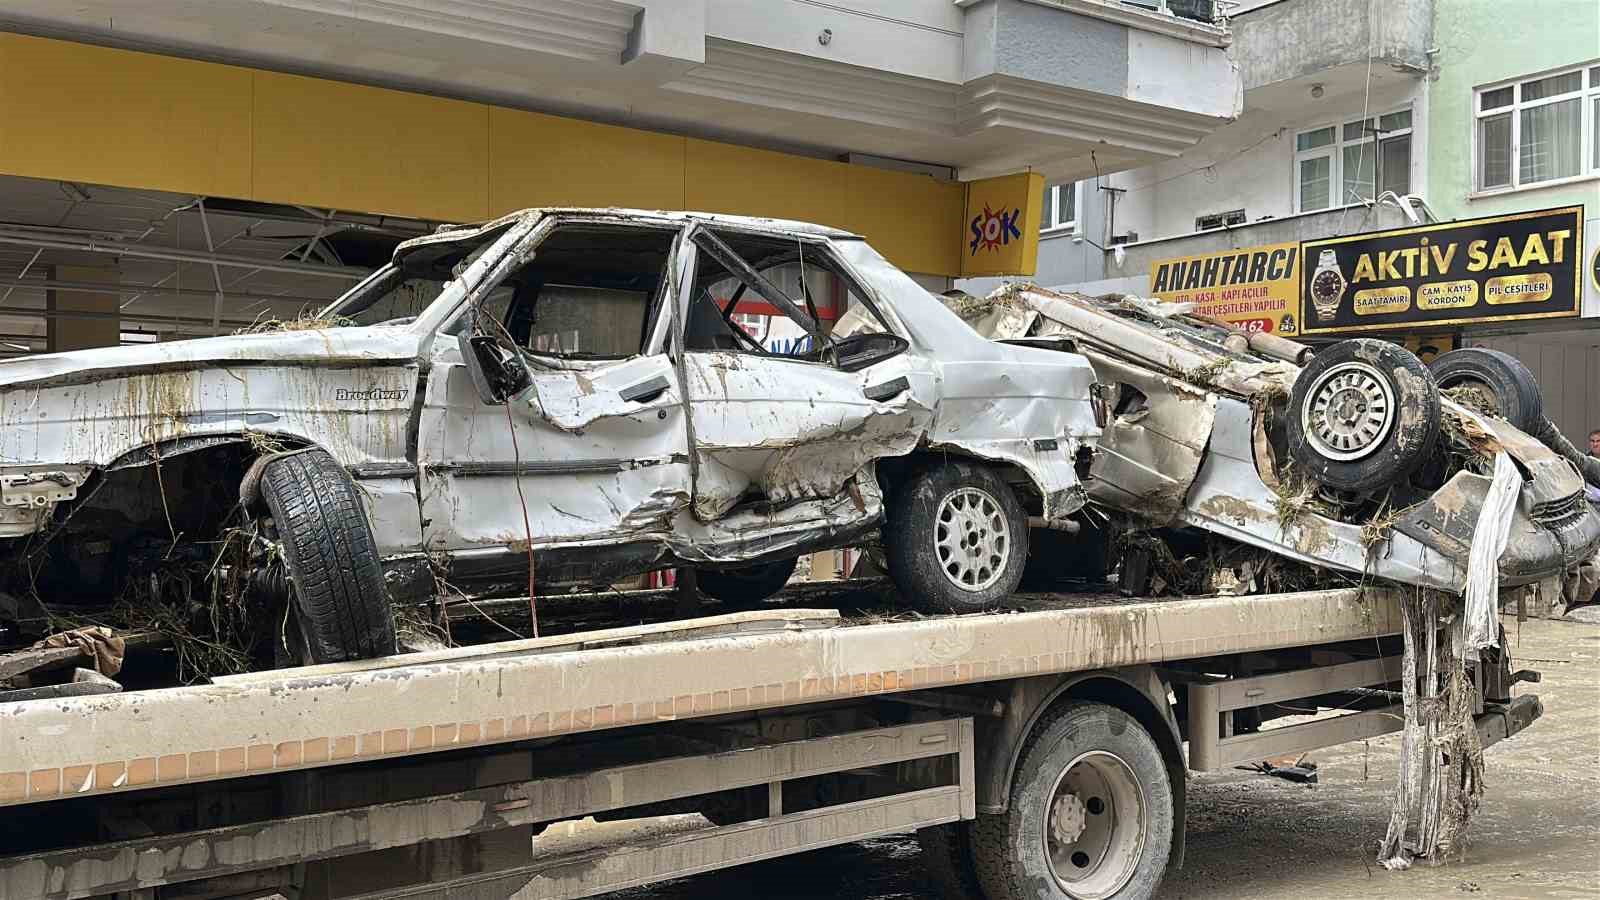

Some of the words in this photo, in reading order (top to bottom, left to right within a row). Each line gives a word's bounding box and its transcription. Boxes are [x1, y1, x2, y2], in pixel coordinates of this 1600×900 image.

[970, 208, 1021, 256] ŞOK
[1352, 237, 1458, 283] AKTİV
[1466, 229, 1571, 272] SAAT
[1152, 247, 1297, 293] ANAHTARCI
[1195, 292, 1216, 303] KASA
[1222, 289, 1240, 300] KAPI
[1422, 287, 1440, 296] CAM
[1253, 299, 1286, 311] YAPILIR
[1428, 296, 1466, 305] KORDON
[336, 388, 409, 401] Broadway
